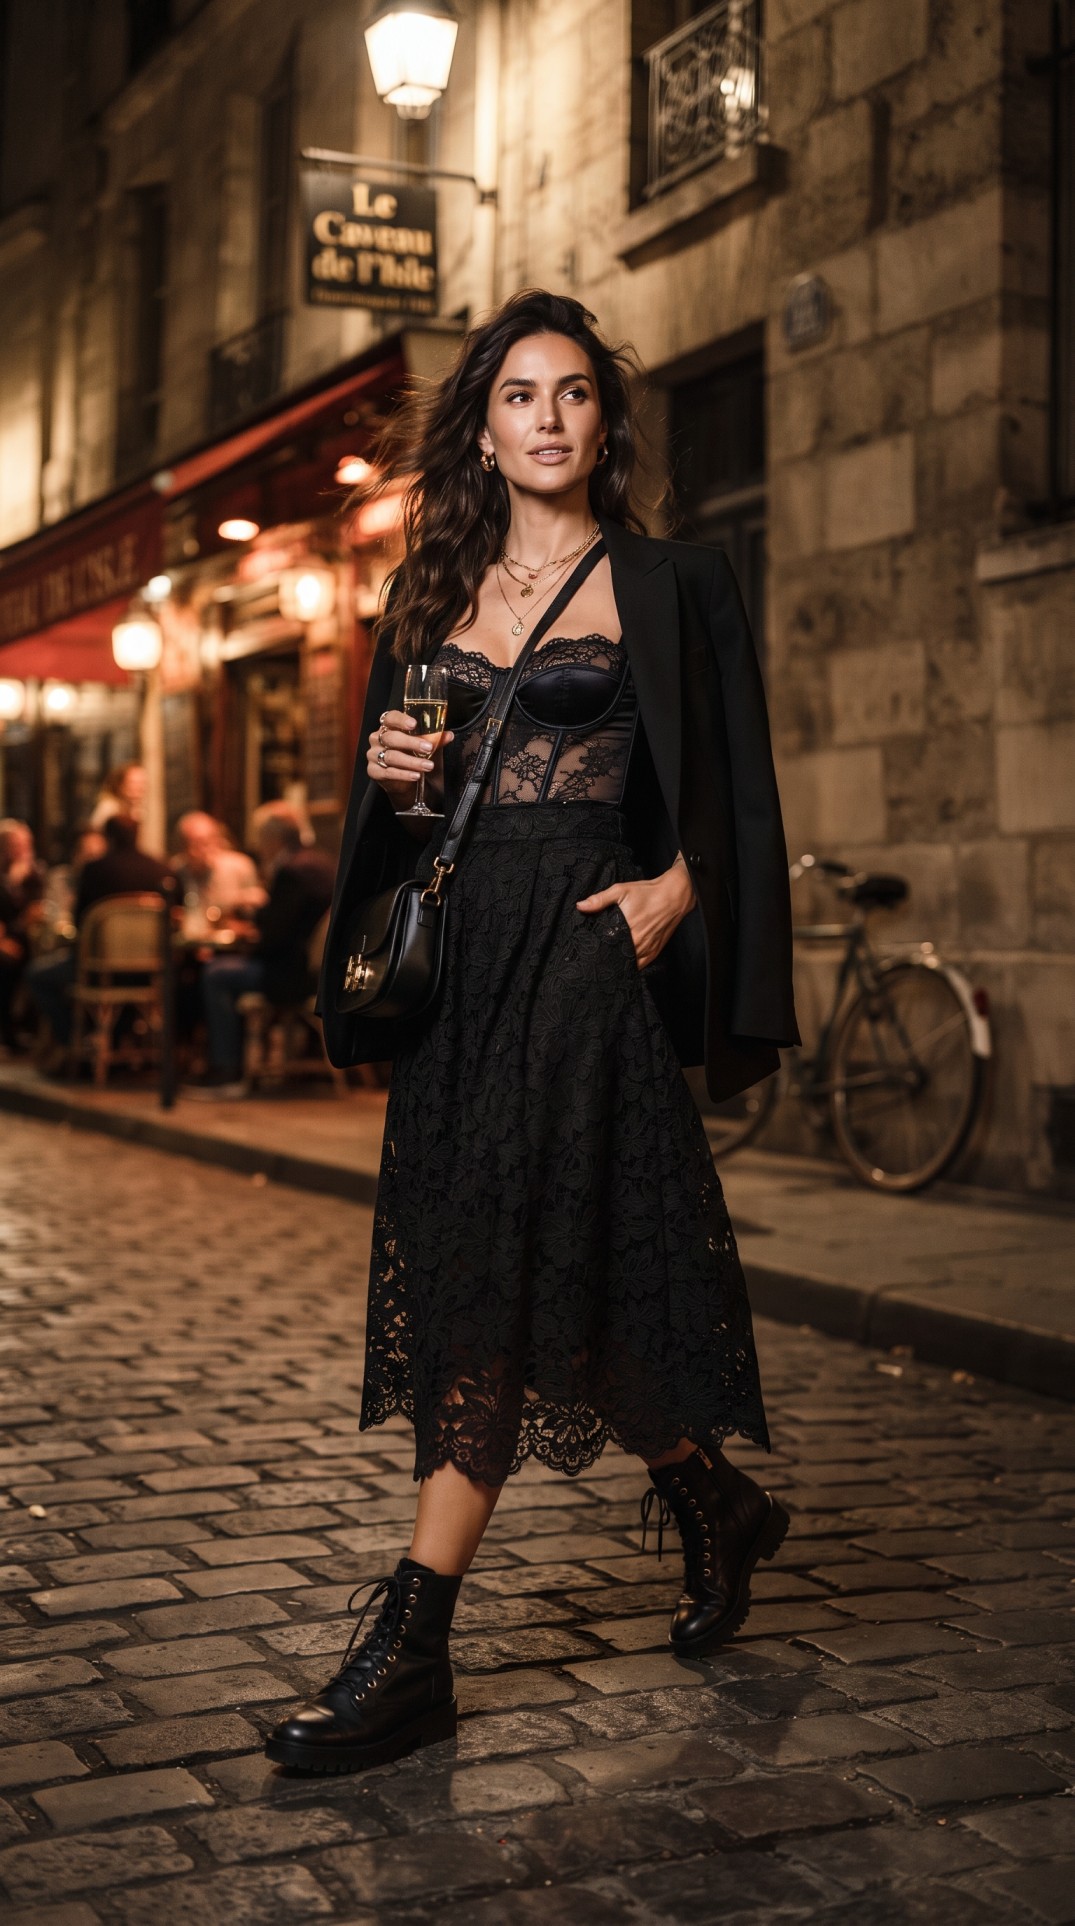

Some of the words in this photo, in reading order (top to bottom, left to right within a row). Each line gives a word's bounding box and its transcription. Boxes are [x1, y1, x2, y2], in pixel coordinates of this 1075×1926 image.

[353, 183, 397, 219] Le
[313, 211, 432, 255] Caveau
[311, 247, 354, 282] de
